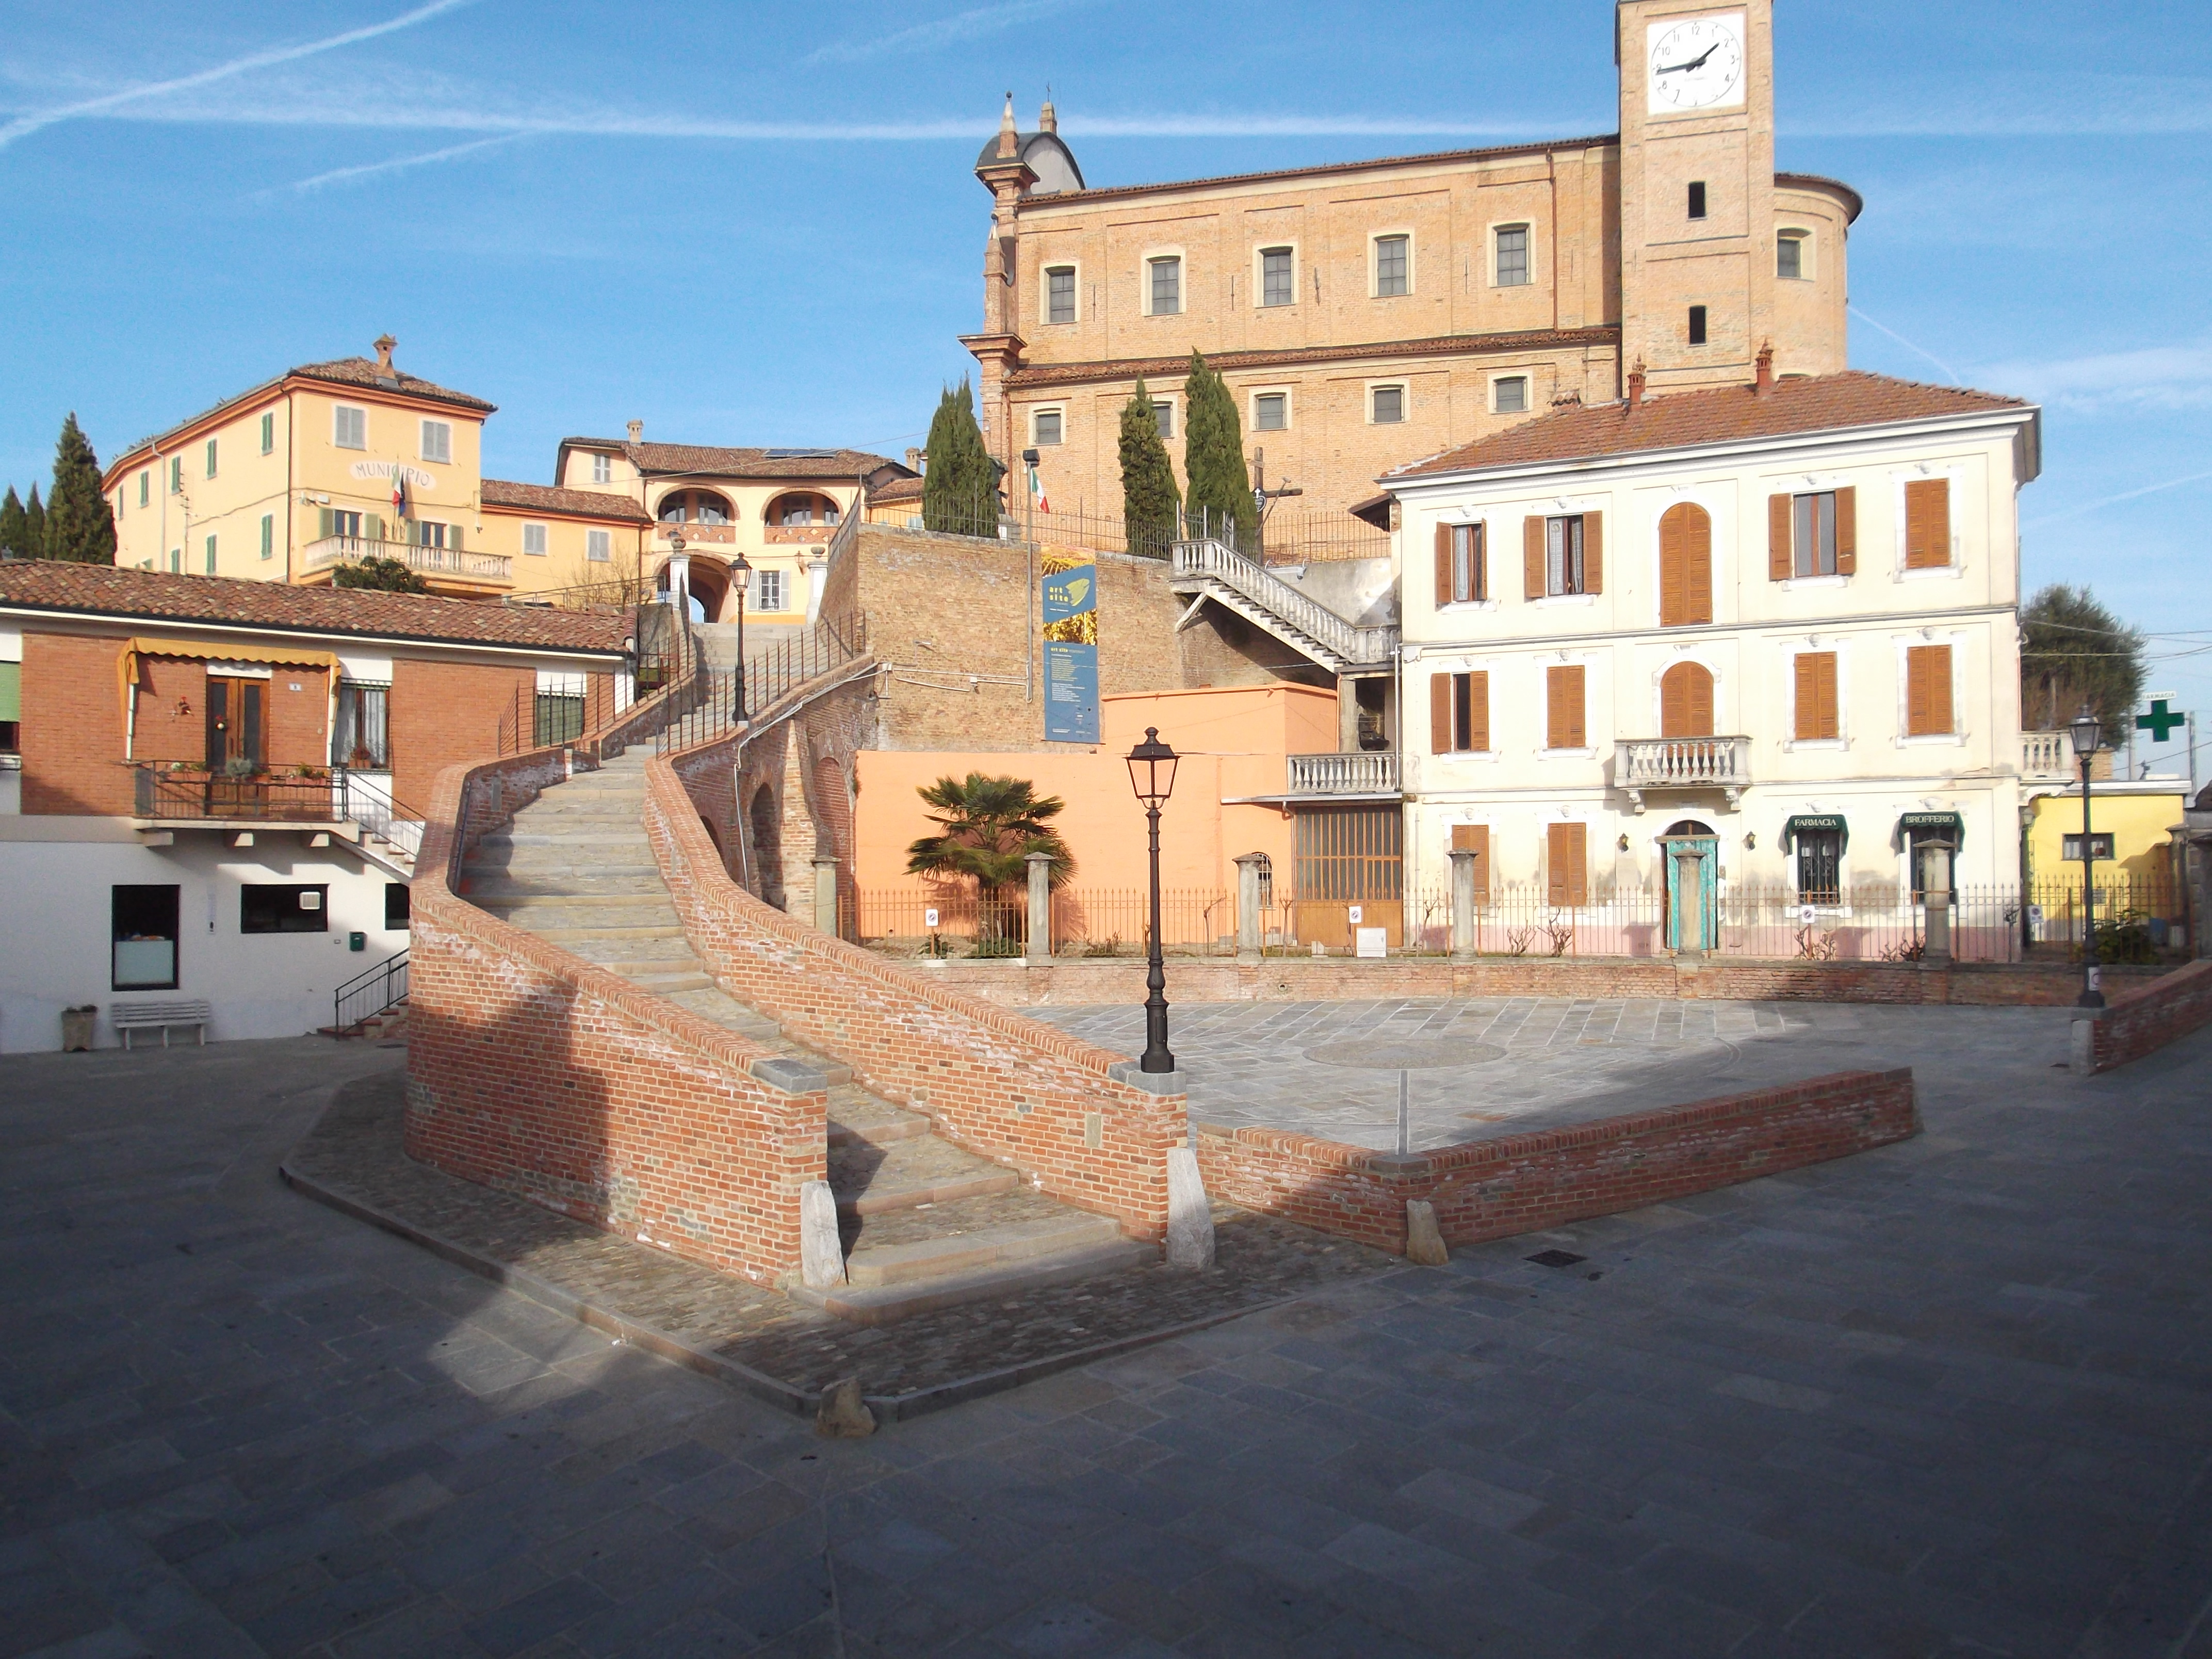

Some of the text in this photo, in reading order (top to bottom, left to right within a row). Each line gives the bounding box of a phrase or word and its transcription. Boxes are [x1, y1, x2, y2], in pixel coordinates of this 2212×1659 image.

[1691, 26, 1700, 36] 12
[1712, 28, 1714, 37] 1
[1673, 34, 1680, 42] 11
[1724, 38, 1729, 48] 2
[1662, 46, 1670, 56] 10
[1730, 55, 1735, 64] 3
[1725, 73, 1730, 83] 4
[1662, 80, 1667, 90] 8
[1675, 89, 1680, 100] 7
[1049, 594, 1068, 602] site
[1906, 815, 1955, 824] BROFFERIO
